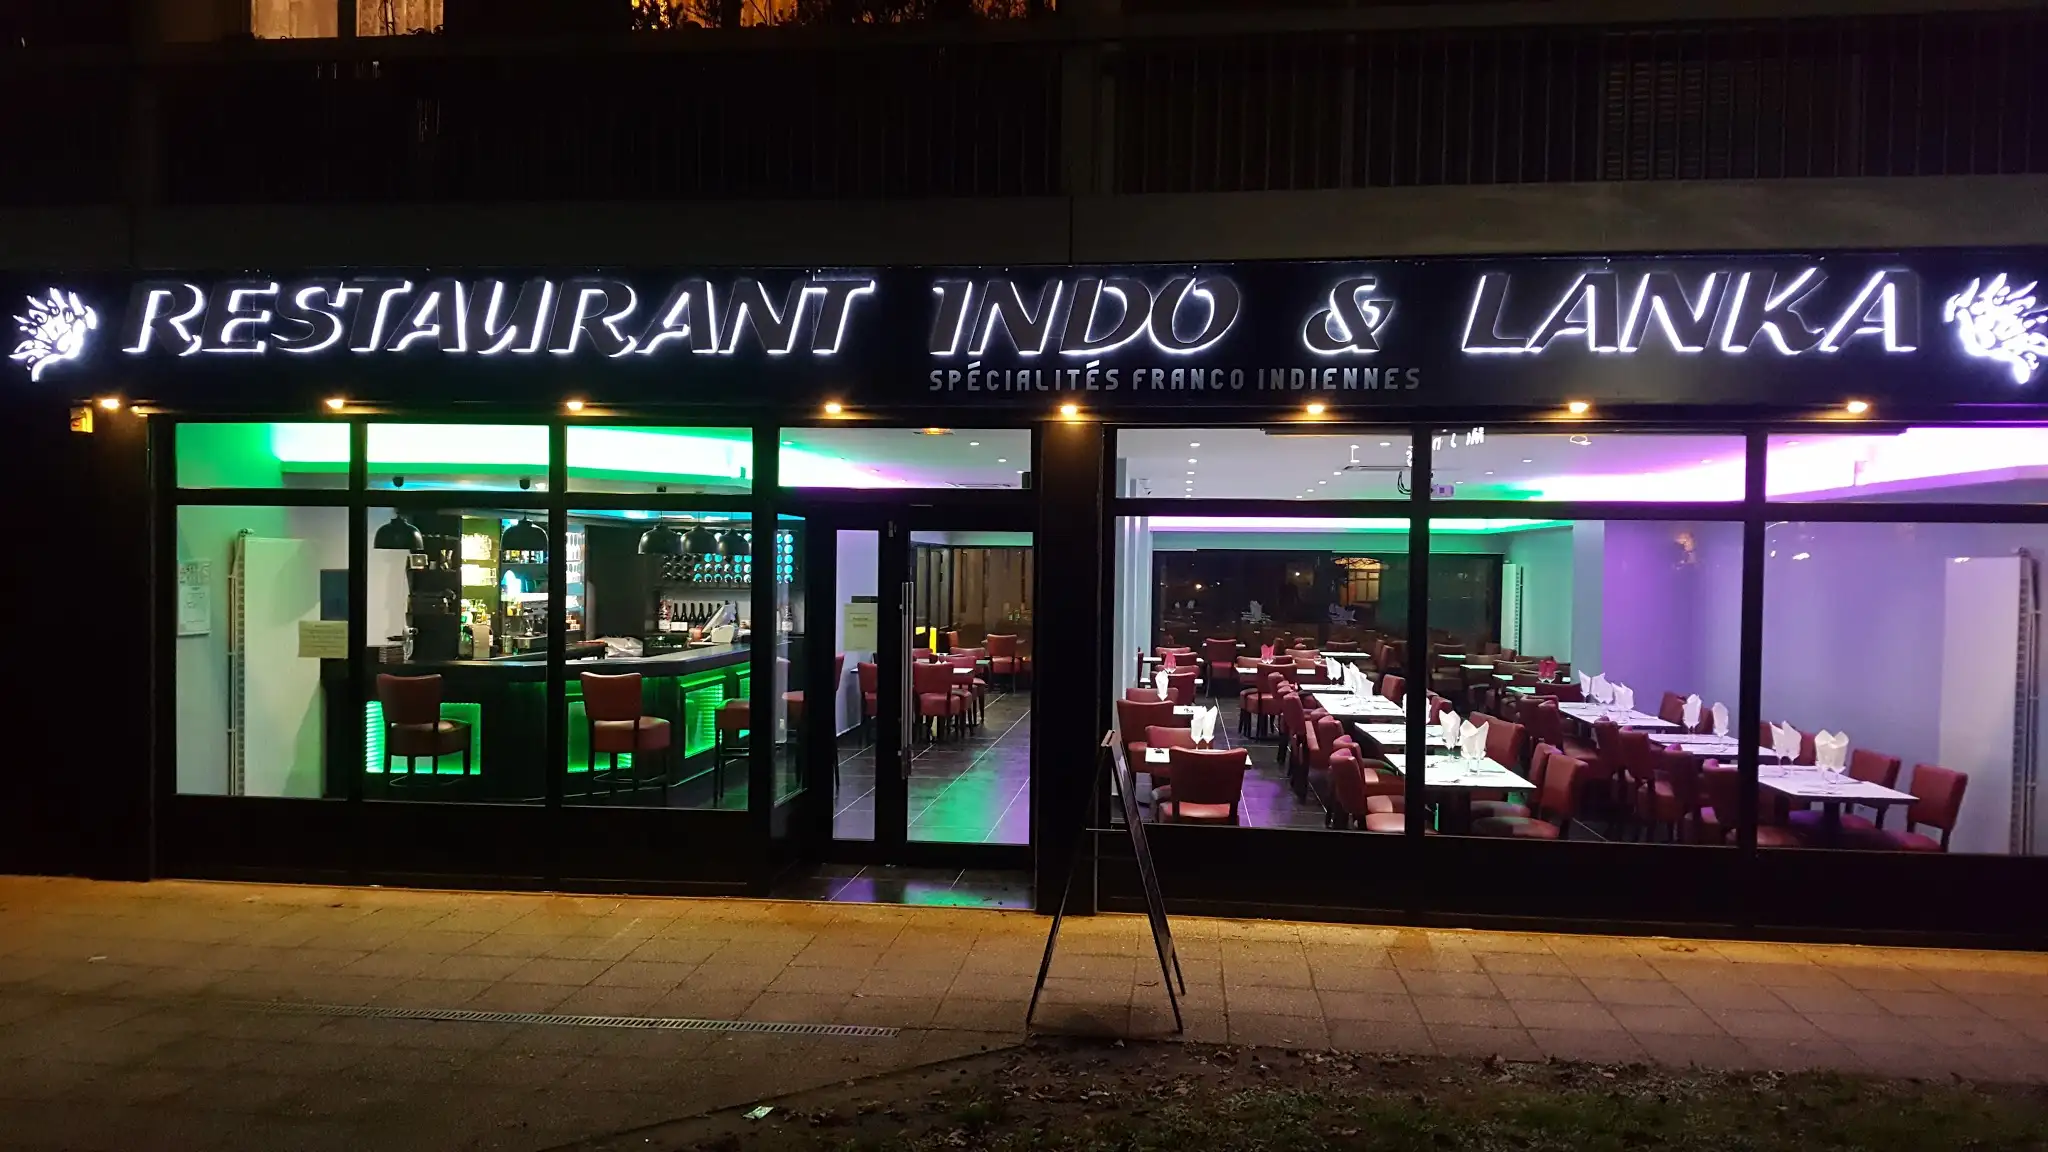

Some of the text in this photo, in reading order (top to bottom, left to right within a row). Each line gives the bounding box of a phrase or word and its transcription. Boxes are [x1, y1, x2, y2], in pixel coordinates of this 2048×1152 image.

[122, 267, 1920, 358] RESTAURANT INDO & LANKA
[929, 360, 1421, 391] SPÉCIALITÉS FRANCO INDIENNES
